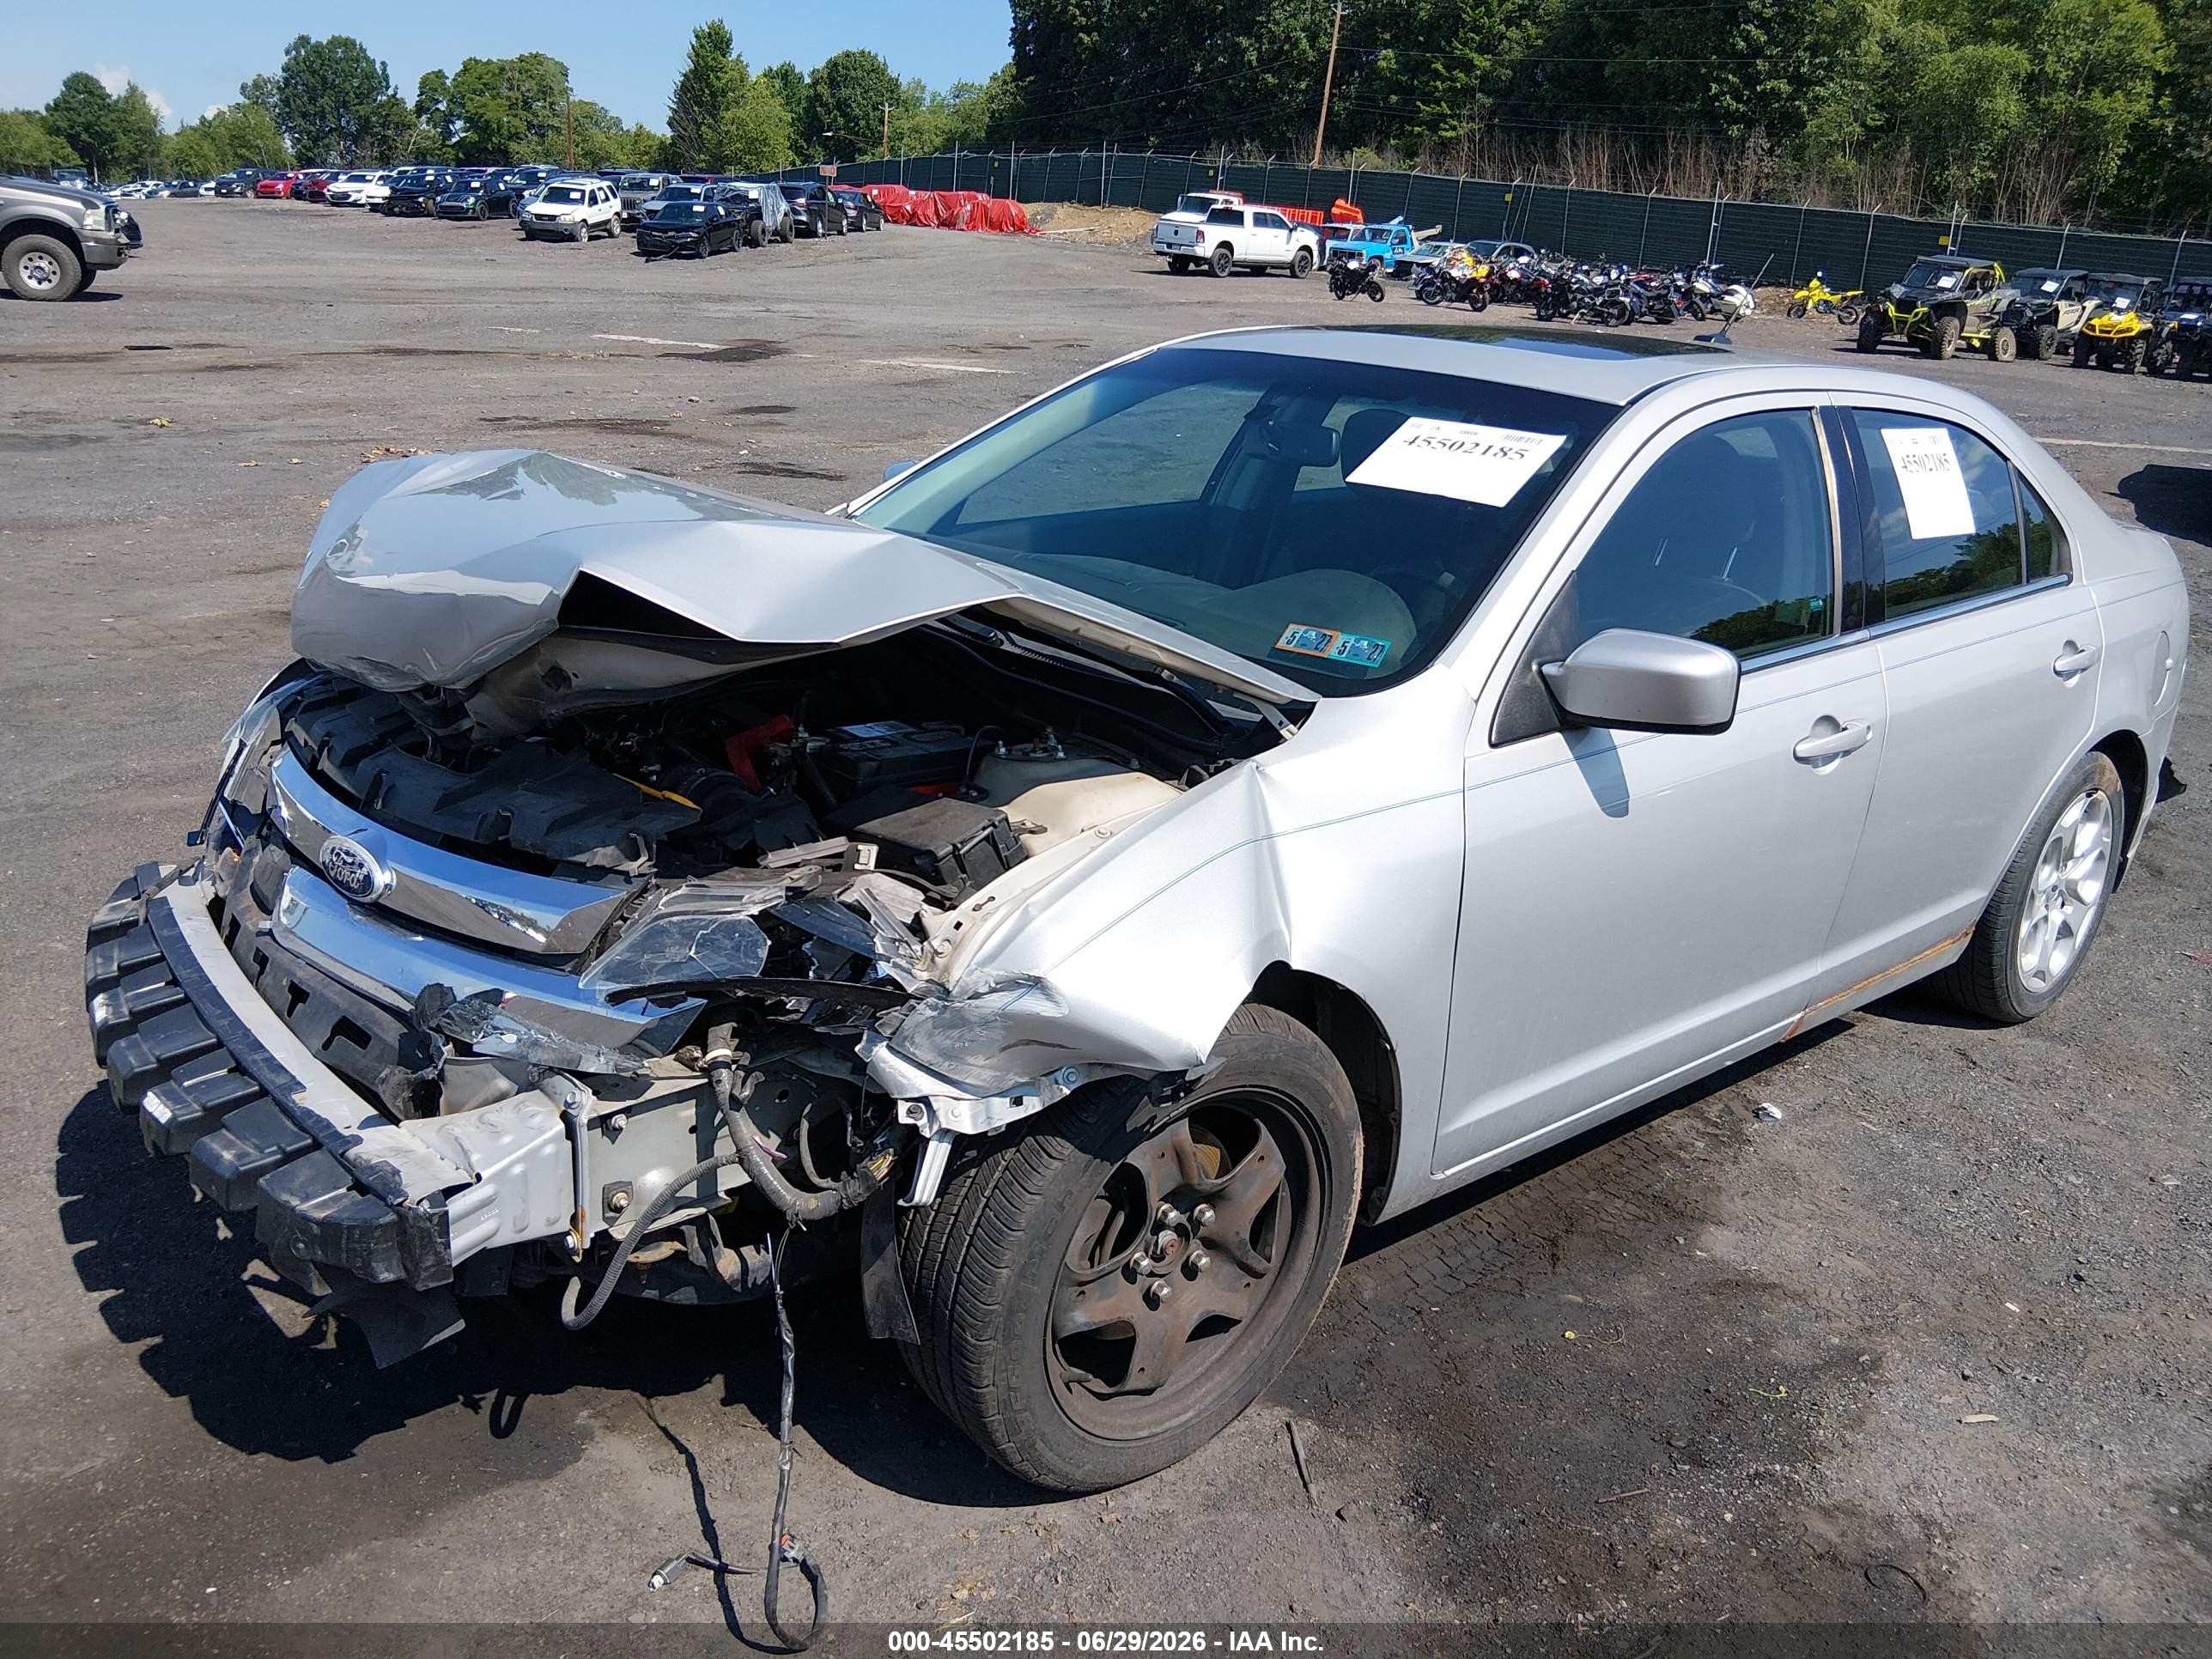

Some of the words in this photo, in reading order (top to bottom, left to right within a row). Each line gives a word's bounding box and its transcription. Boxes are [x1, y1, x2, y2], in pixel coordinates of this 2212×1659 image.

[1403, 434, 1529, 460] 45502185
[1901, 453, 1951, 473] 45502185
[1285, 630, 1300, 646] 5
[1314, 633, 1333, 653] 27
[1338, 641, 1351, 656] 5
[1367, 643, 1385, 662] 27
[328, 847, 367, 890] Ford
